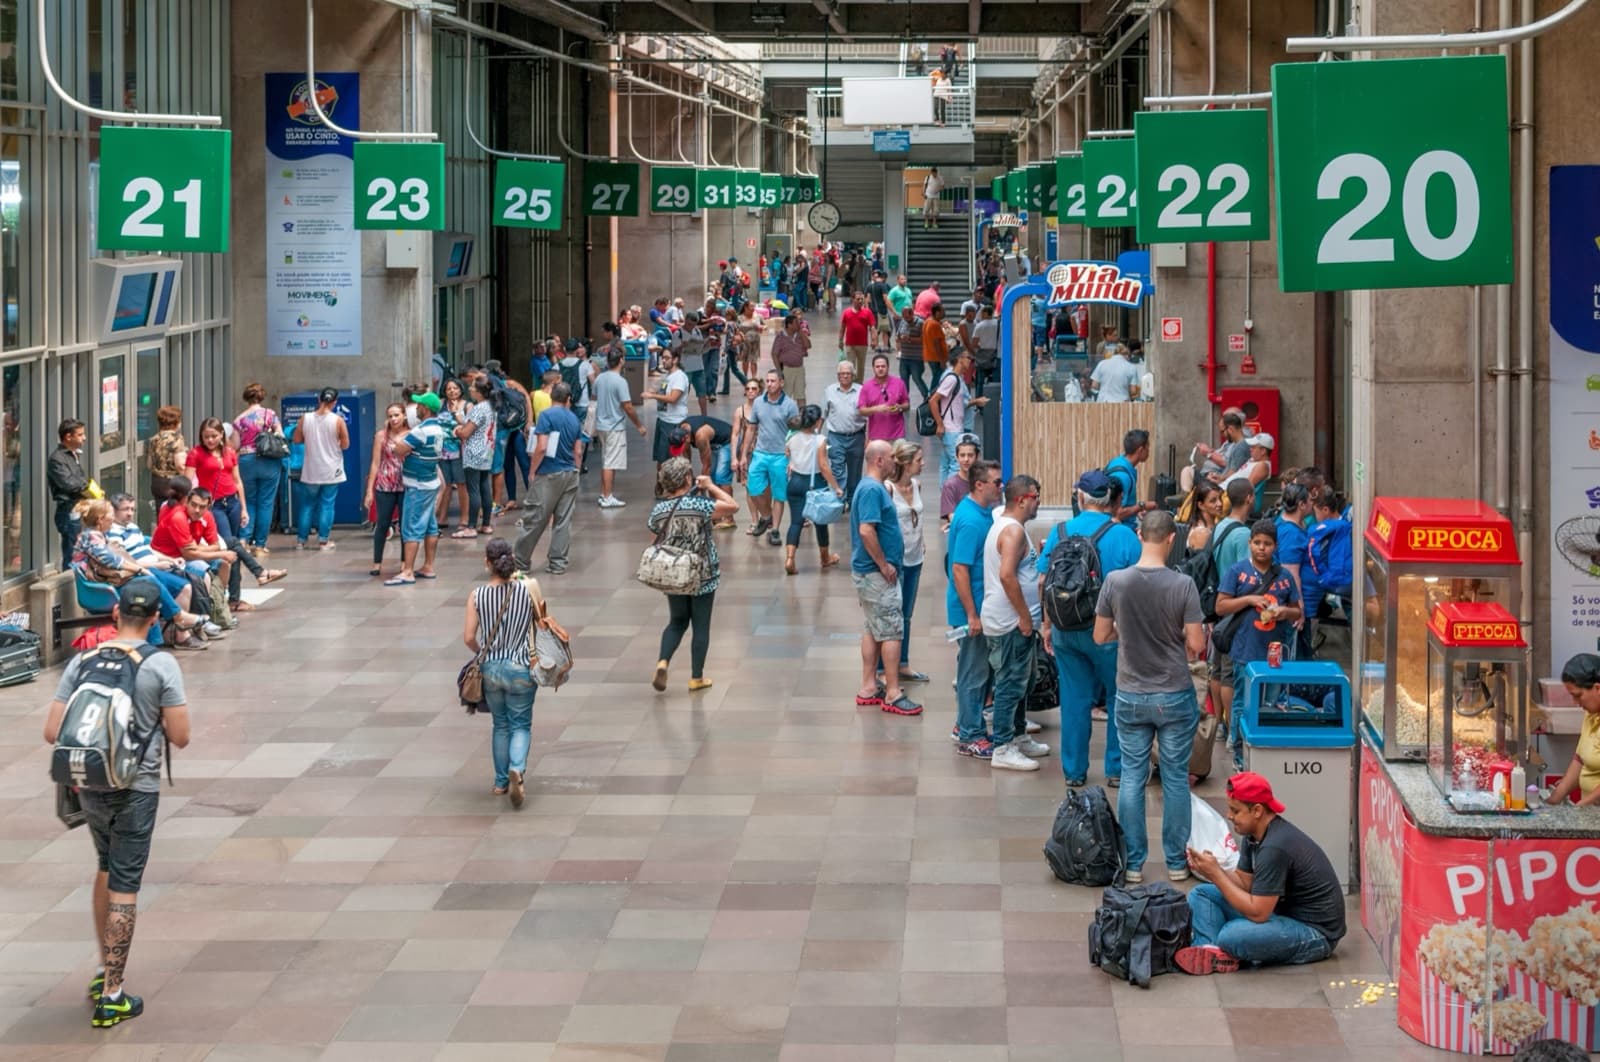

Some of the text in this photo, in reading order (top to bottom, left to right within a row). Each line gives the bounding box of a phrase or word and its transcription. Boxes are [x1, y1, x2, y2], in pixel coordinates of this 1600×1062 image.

[365, 177, 431, 221] 23
[503, 186, 552, 222] 25
[592, 183, 631, 210] 27
[656, 184, 691, 208] 29
[704, 184, 729, 205] 31
[1097, 174, 1136, 218] 2
[1156, 162, 1252, 228] 22
[1316, 149, 1480, 264] 20
[120, 176, 203, 239] 21
[1412, 529, 1499, 549] PIPOCA
[1572, 595, 1585, 605] Só
[1572, 608, 1578, 616] e
[1580, 608, 1586, 616] a
[1455, 625, 1516, 639] PIPOCA
[1572, 618, 1583, 626] de
[1284, 762, 1323, 775] LIXO
